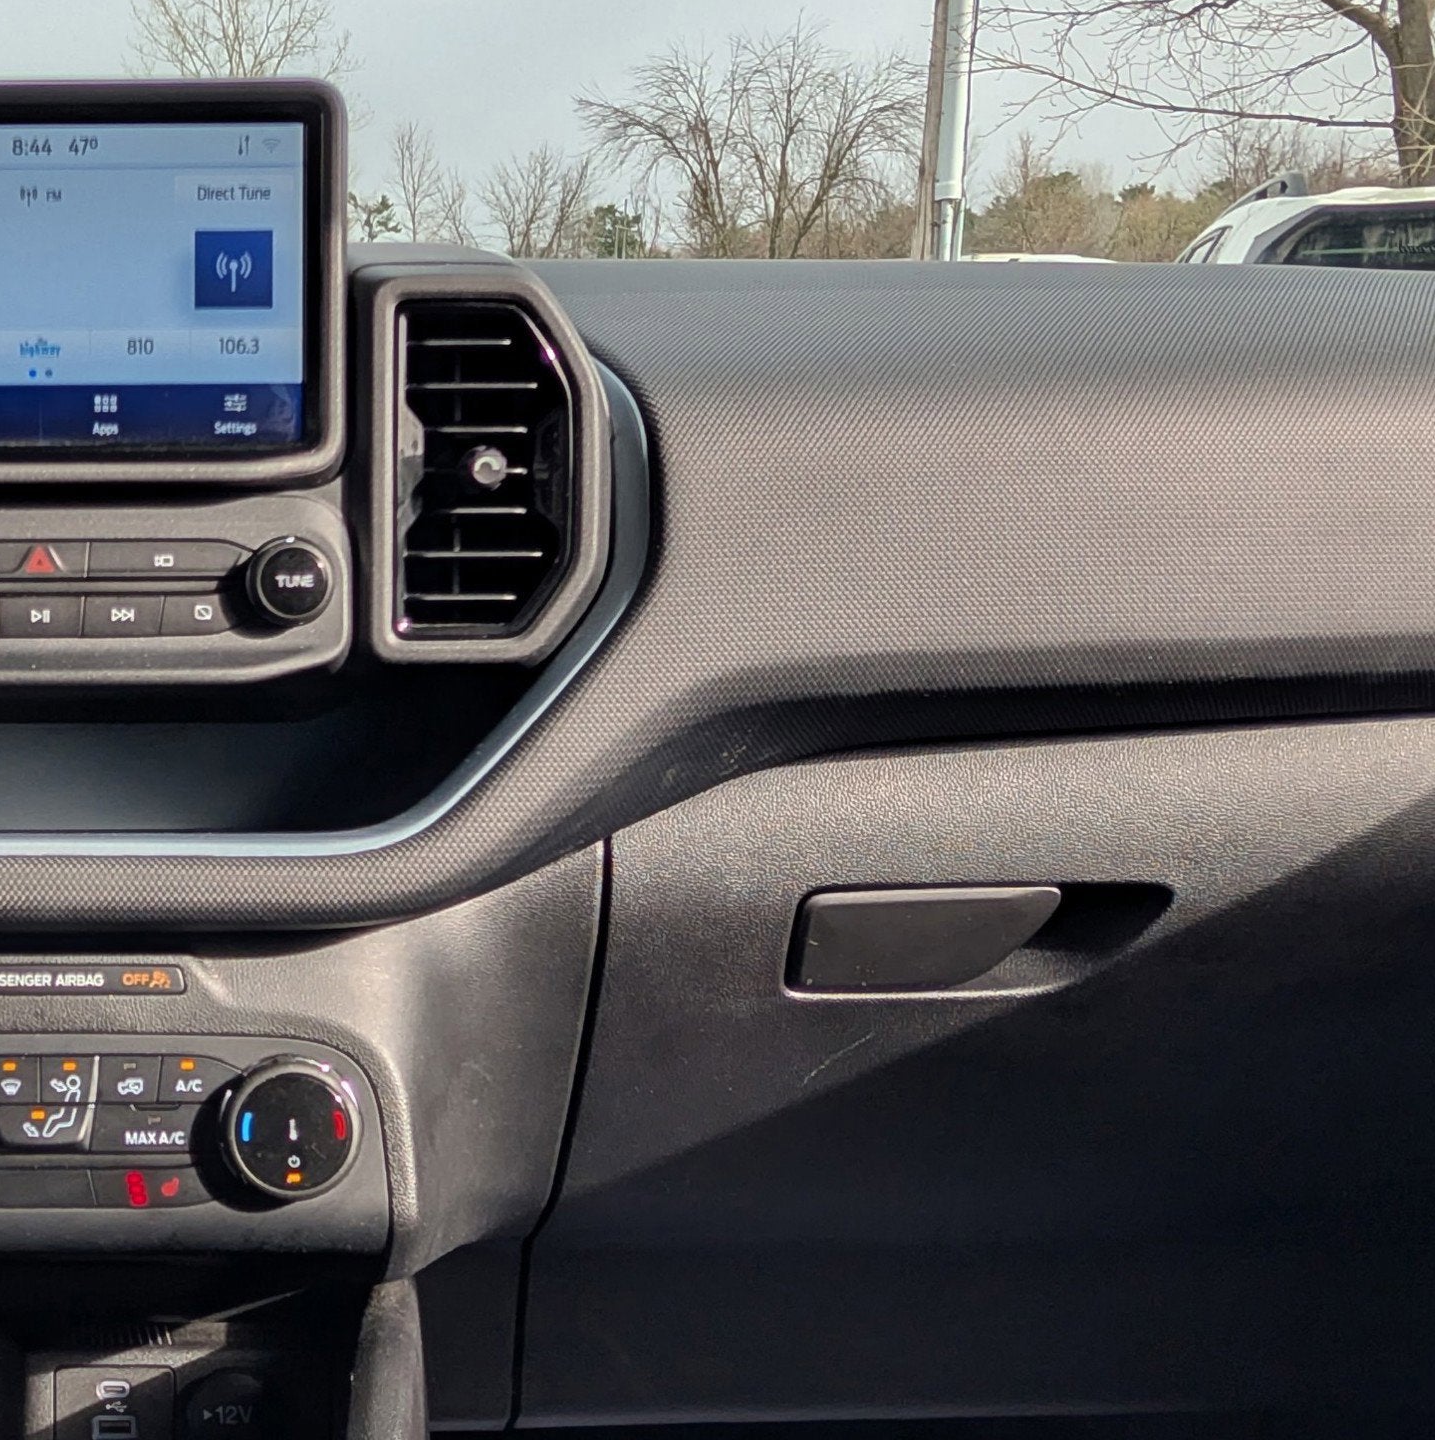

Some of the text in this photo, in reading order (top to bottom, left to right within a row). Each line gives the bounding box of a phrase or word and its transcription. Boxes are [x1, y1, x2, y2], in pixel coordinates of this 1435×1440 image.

[12, 138, 53, 157] 8:44
[45, 190, 63, 203] FM
[196, 185, 272, 201] Direct Tune
[126, 336, 155, 356] 810
[218, 336, 261, 356] 106.3
[92, 422, 120, 437] Apps
[213, 420, 258, 437] Settings
[274, 573, 315, 589] TUNE
[54, 972, 106, 988] AIRBAG
[121, 972, 150, 987] OFF
[174, 1078, 204, 1093] A/C
[124, 1130, 186, 1146] MAX A/C
[215, 1405, 253, 1426] 12V
